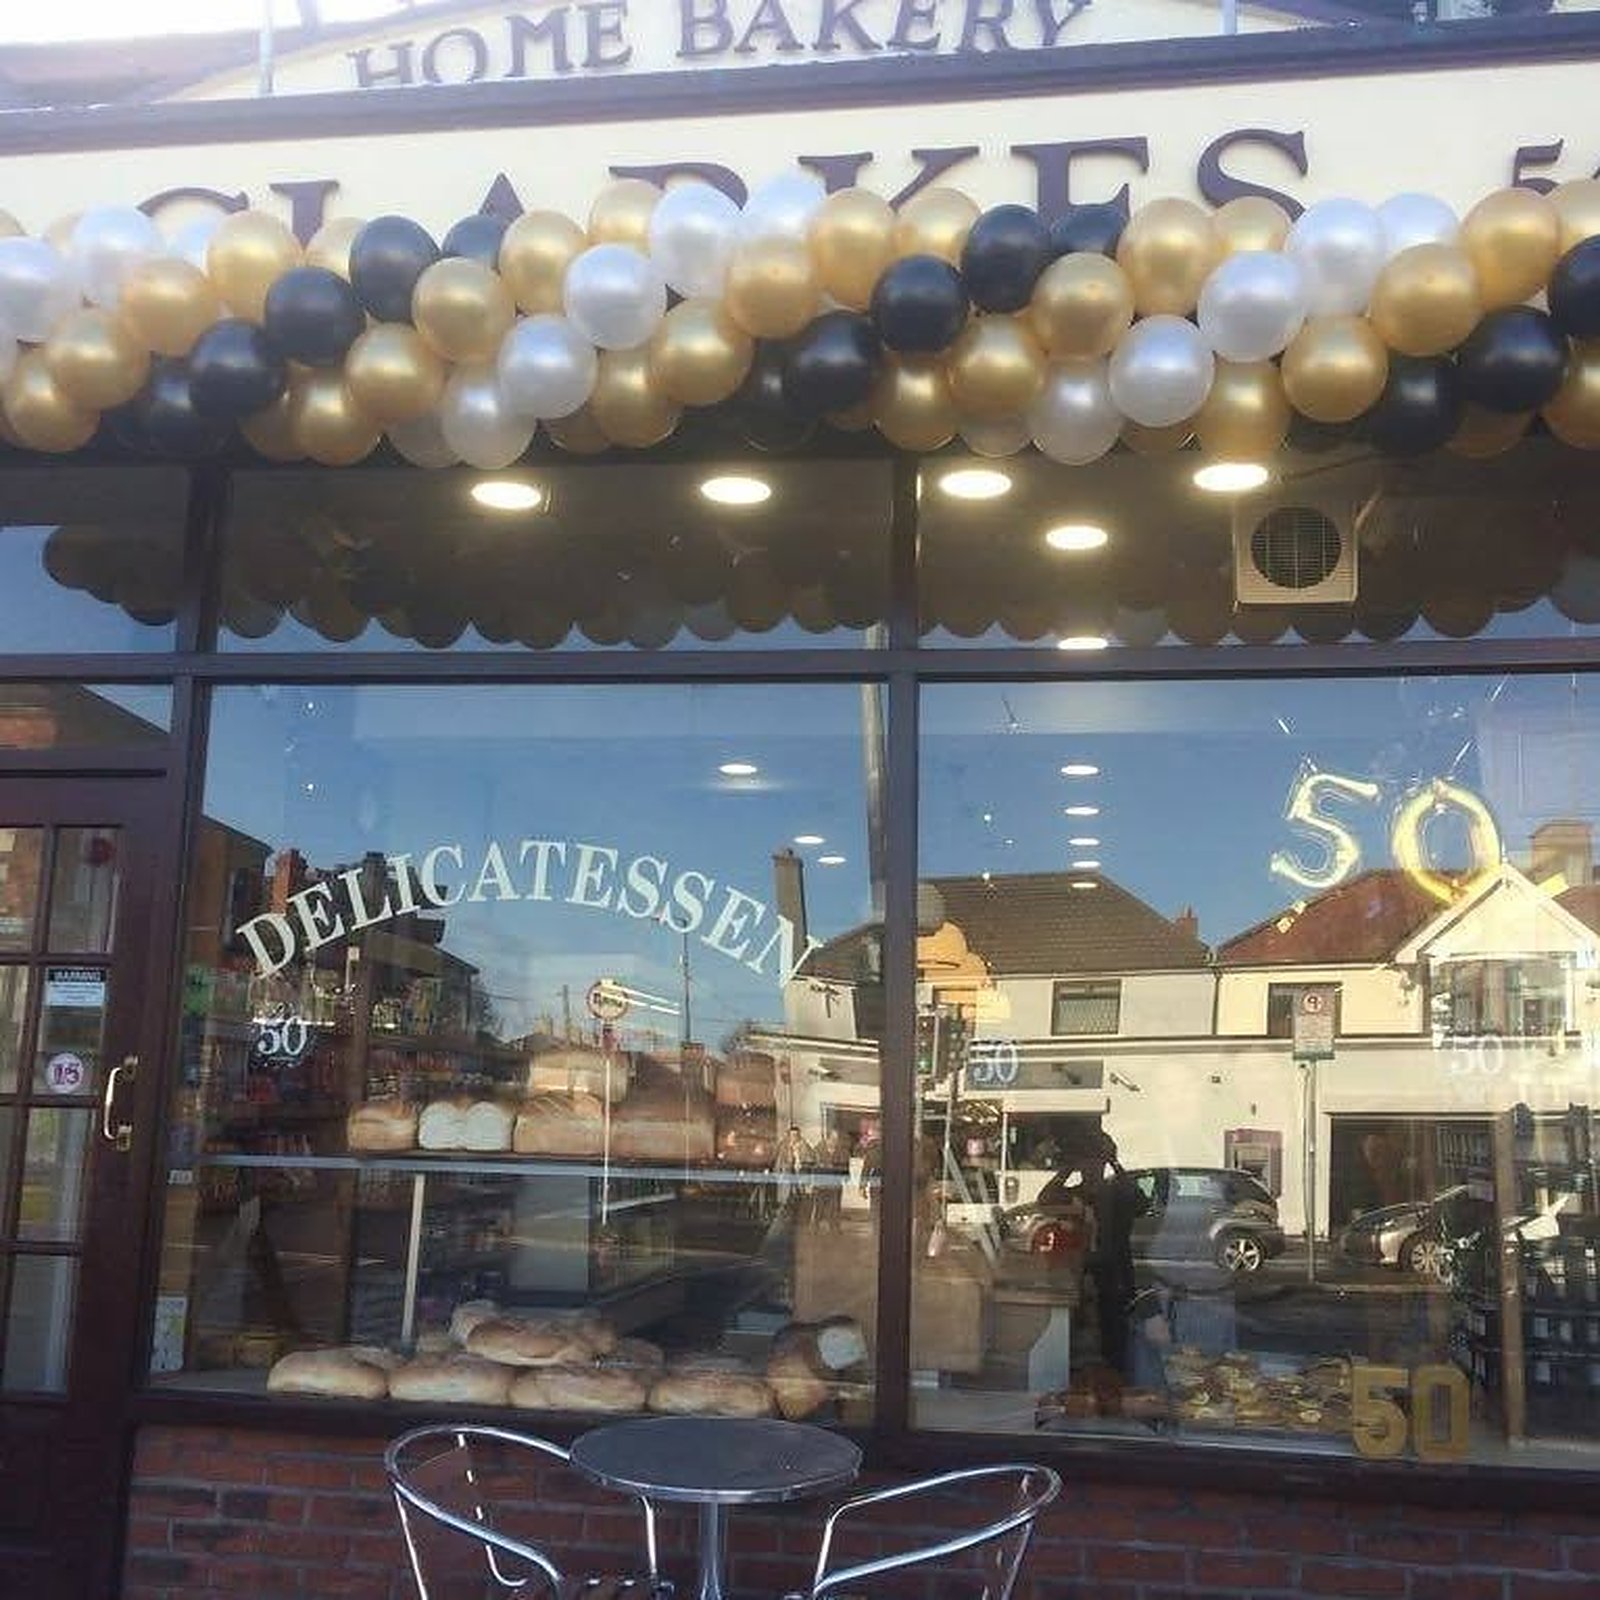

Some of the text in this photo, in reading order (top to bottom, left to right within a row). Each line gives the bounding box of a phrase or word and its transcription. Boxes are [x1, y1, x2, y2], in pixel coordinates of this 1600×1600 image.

[347, 0, 1091, 88] HOME BAKERY
[1270, 773, 1502, 906] 50
[235, 840, 824, 989] DELICATESSEN
[257, 1017, 307, 1056] 50
[1352, 1365, 1470, 1463] 50
